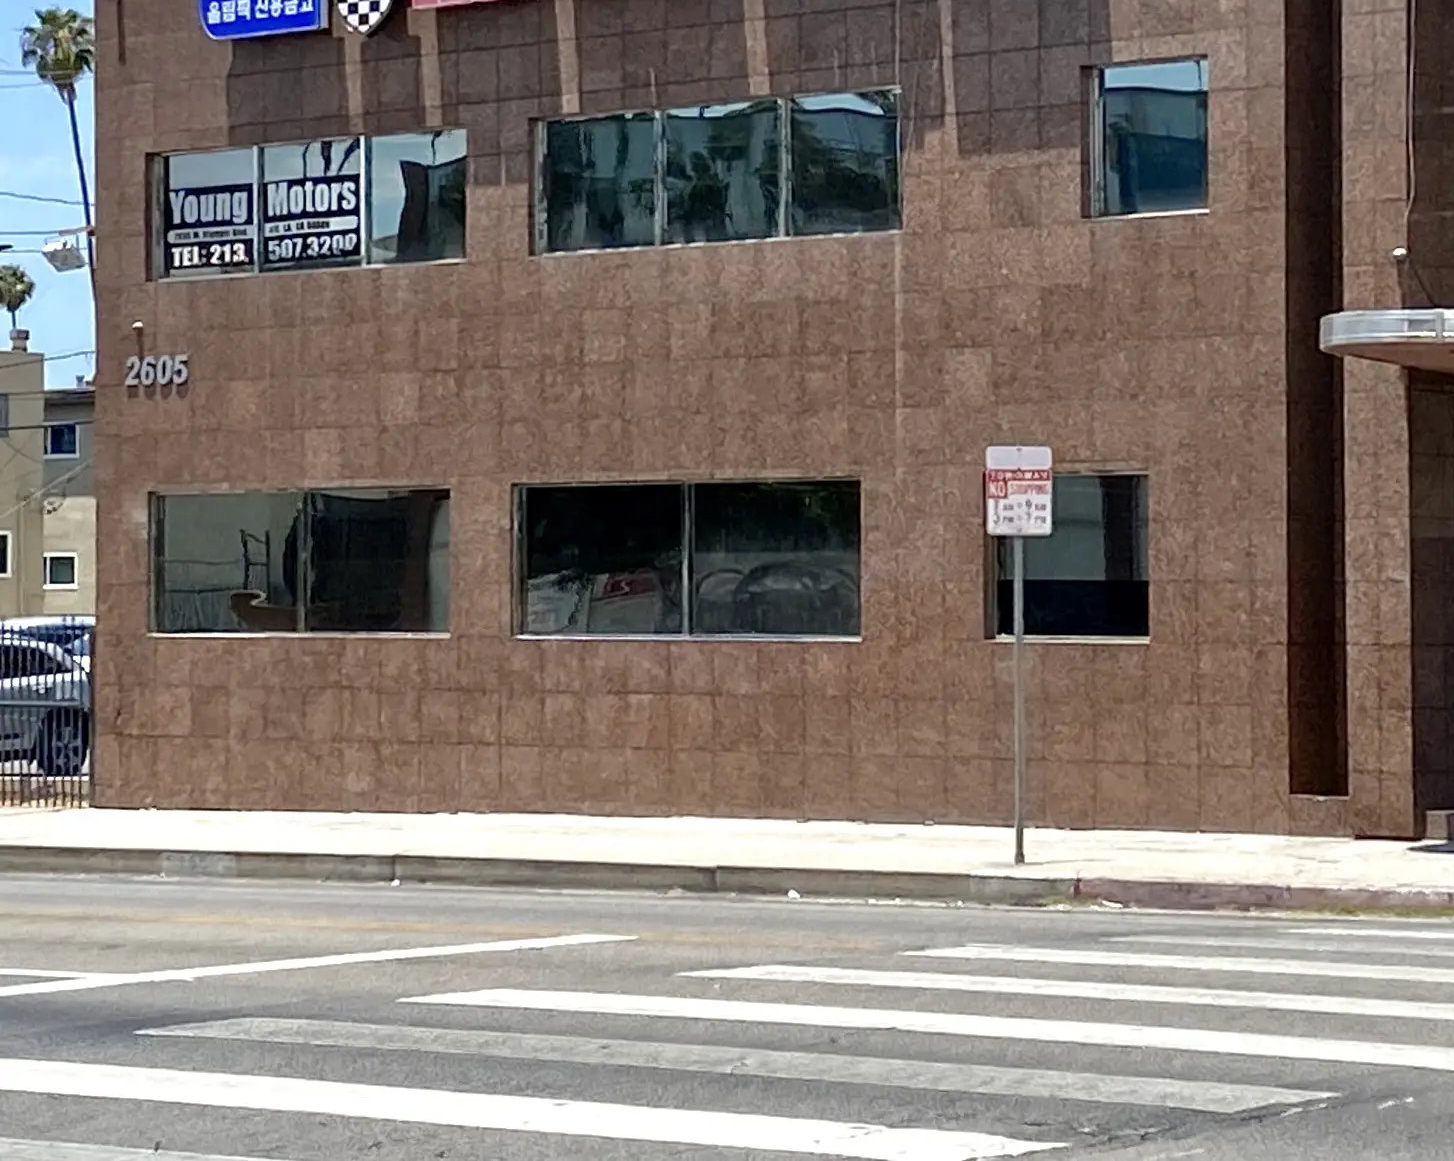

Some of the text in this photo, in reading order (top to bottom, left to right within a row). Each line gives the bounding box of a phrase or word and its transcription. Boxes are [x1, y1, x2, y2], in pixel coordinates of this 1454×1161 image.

[169, 181, 356, 225] Young Motors
[125, 354, 189, 386] 2605
[989, 482, 1006, 496] NO
